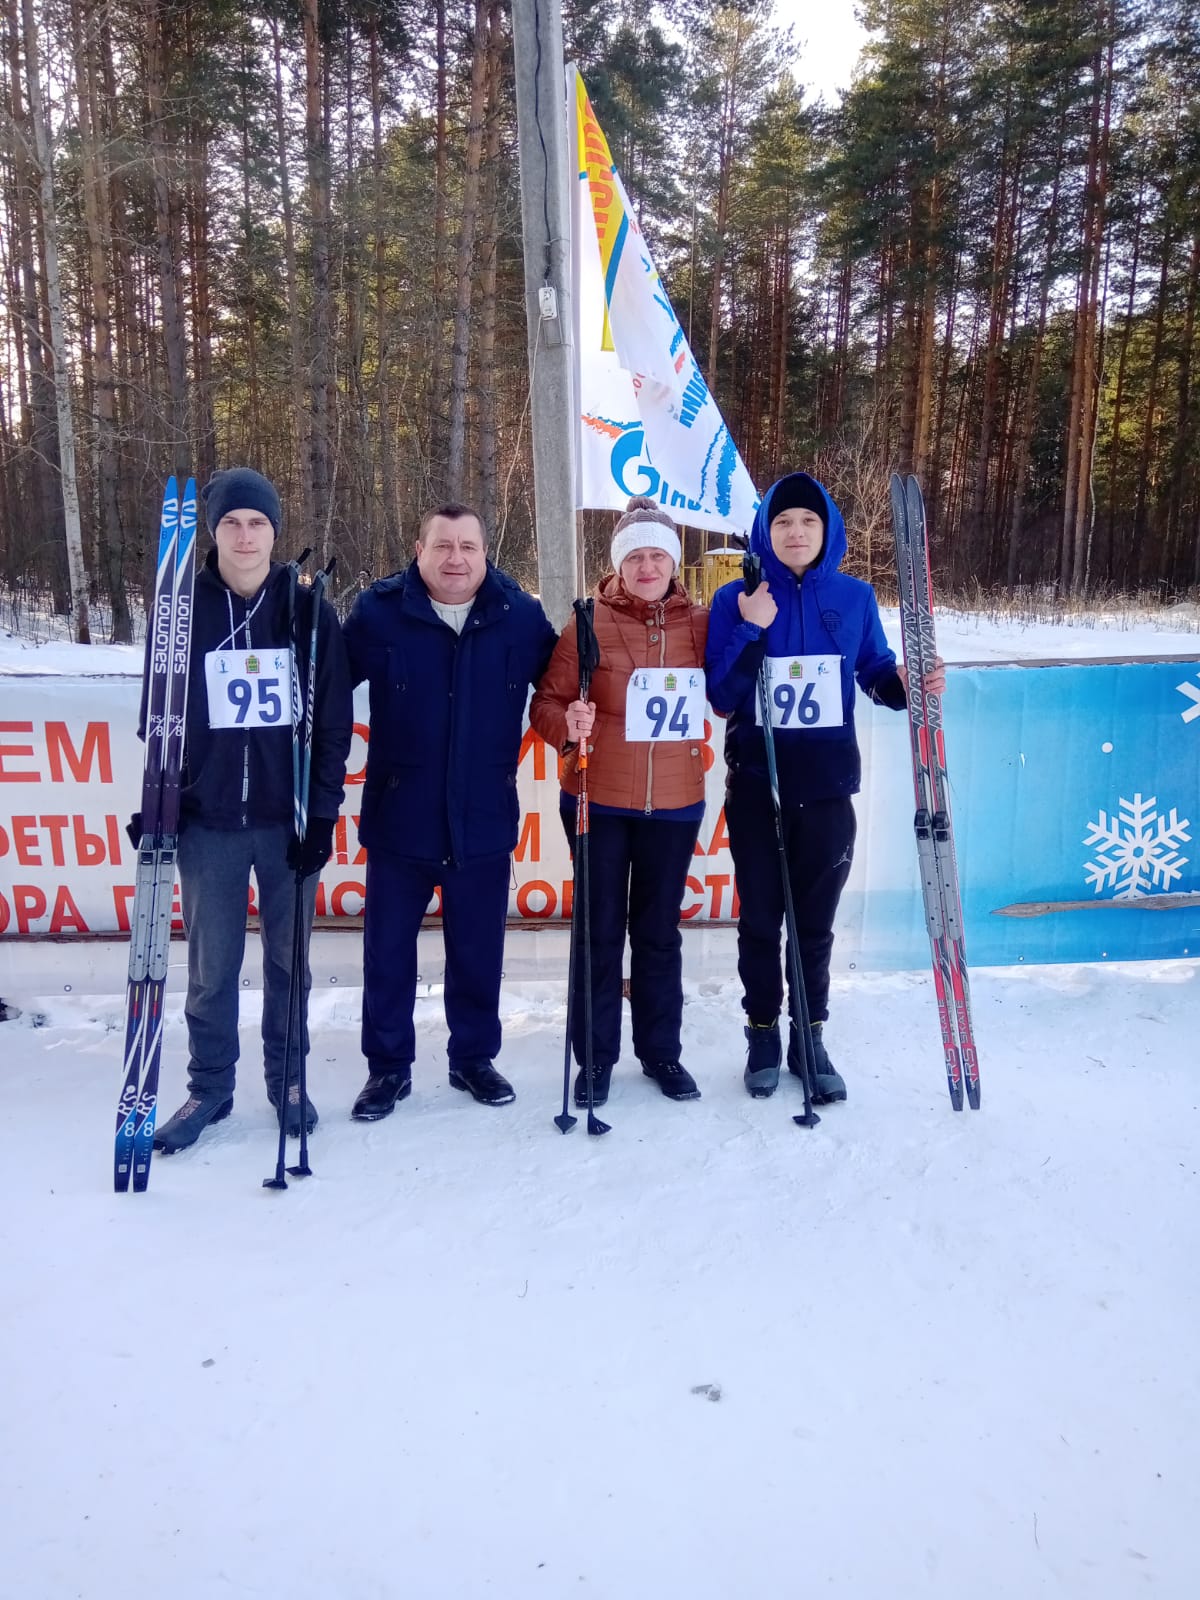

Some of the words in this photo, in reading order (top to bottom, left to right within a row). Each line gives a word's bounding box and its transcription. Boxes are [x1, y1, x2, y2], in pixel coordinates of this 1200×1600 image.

[903, 598, 925, 727] NORDWAY
[918, 602, 943, 730] NODWAY
[227, 678, 282, 724] 95
[645, 696, 690, 738] 94
[773, 682, 821, 725] 96
[116, 1091, 138, 1116] RS
[136, 1091, 157, 1116] RS
[124, 1121, 135, 1137] 8
[143, 1121, 154, 1137] 8
